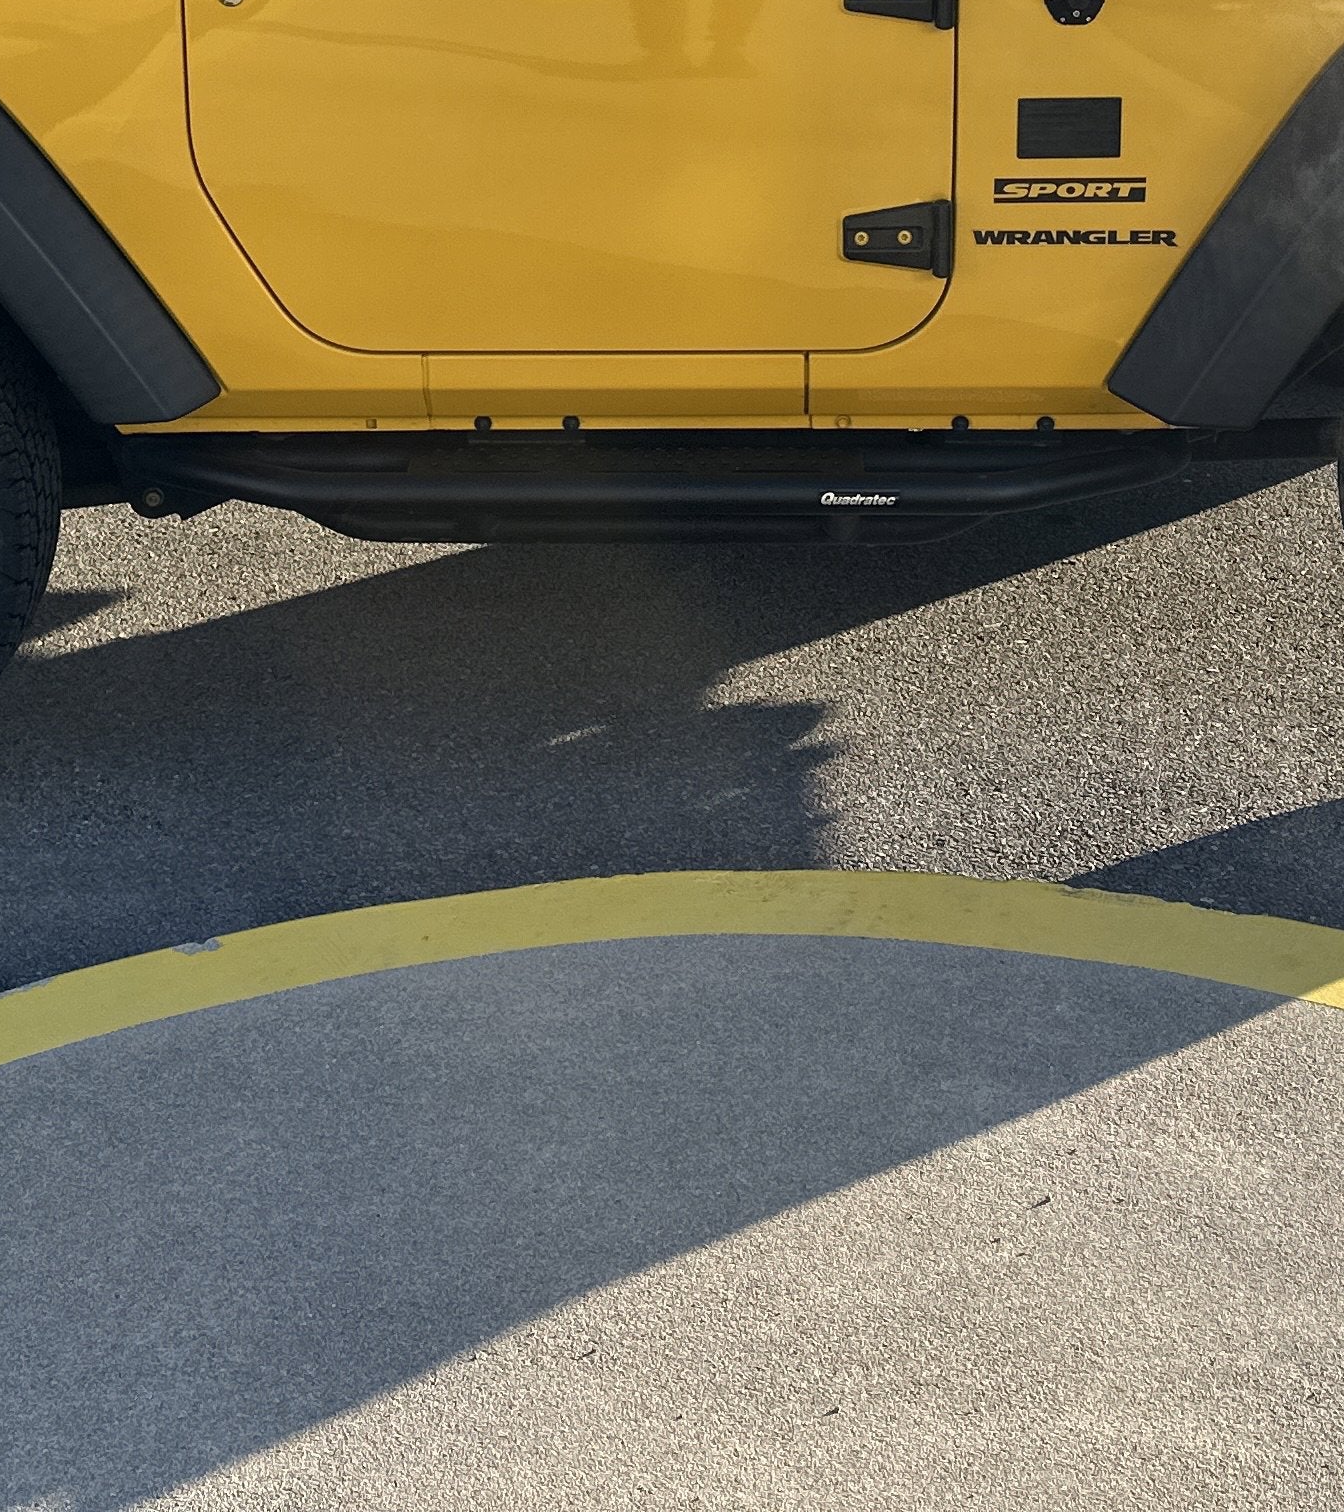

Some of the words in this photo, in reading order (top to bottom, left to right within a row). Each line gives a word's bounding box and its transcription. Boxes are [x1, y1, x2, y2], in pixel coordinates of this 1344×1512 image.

[994, 181, 1146, 199] SPORT
[973, 230, 1178, 247] WRANGLER
[820, 491, 897, 506] Quadratec
